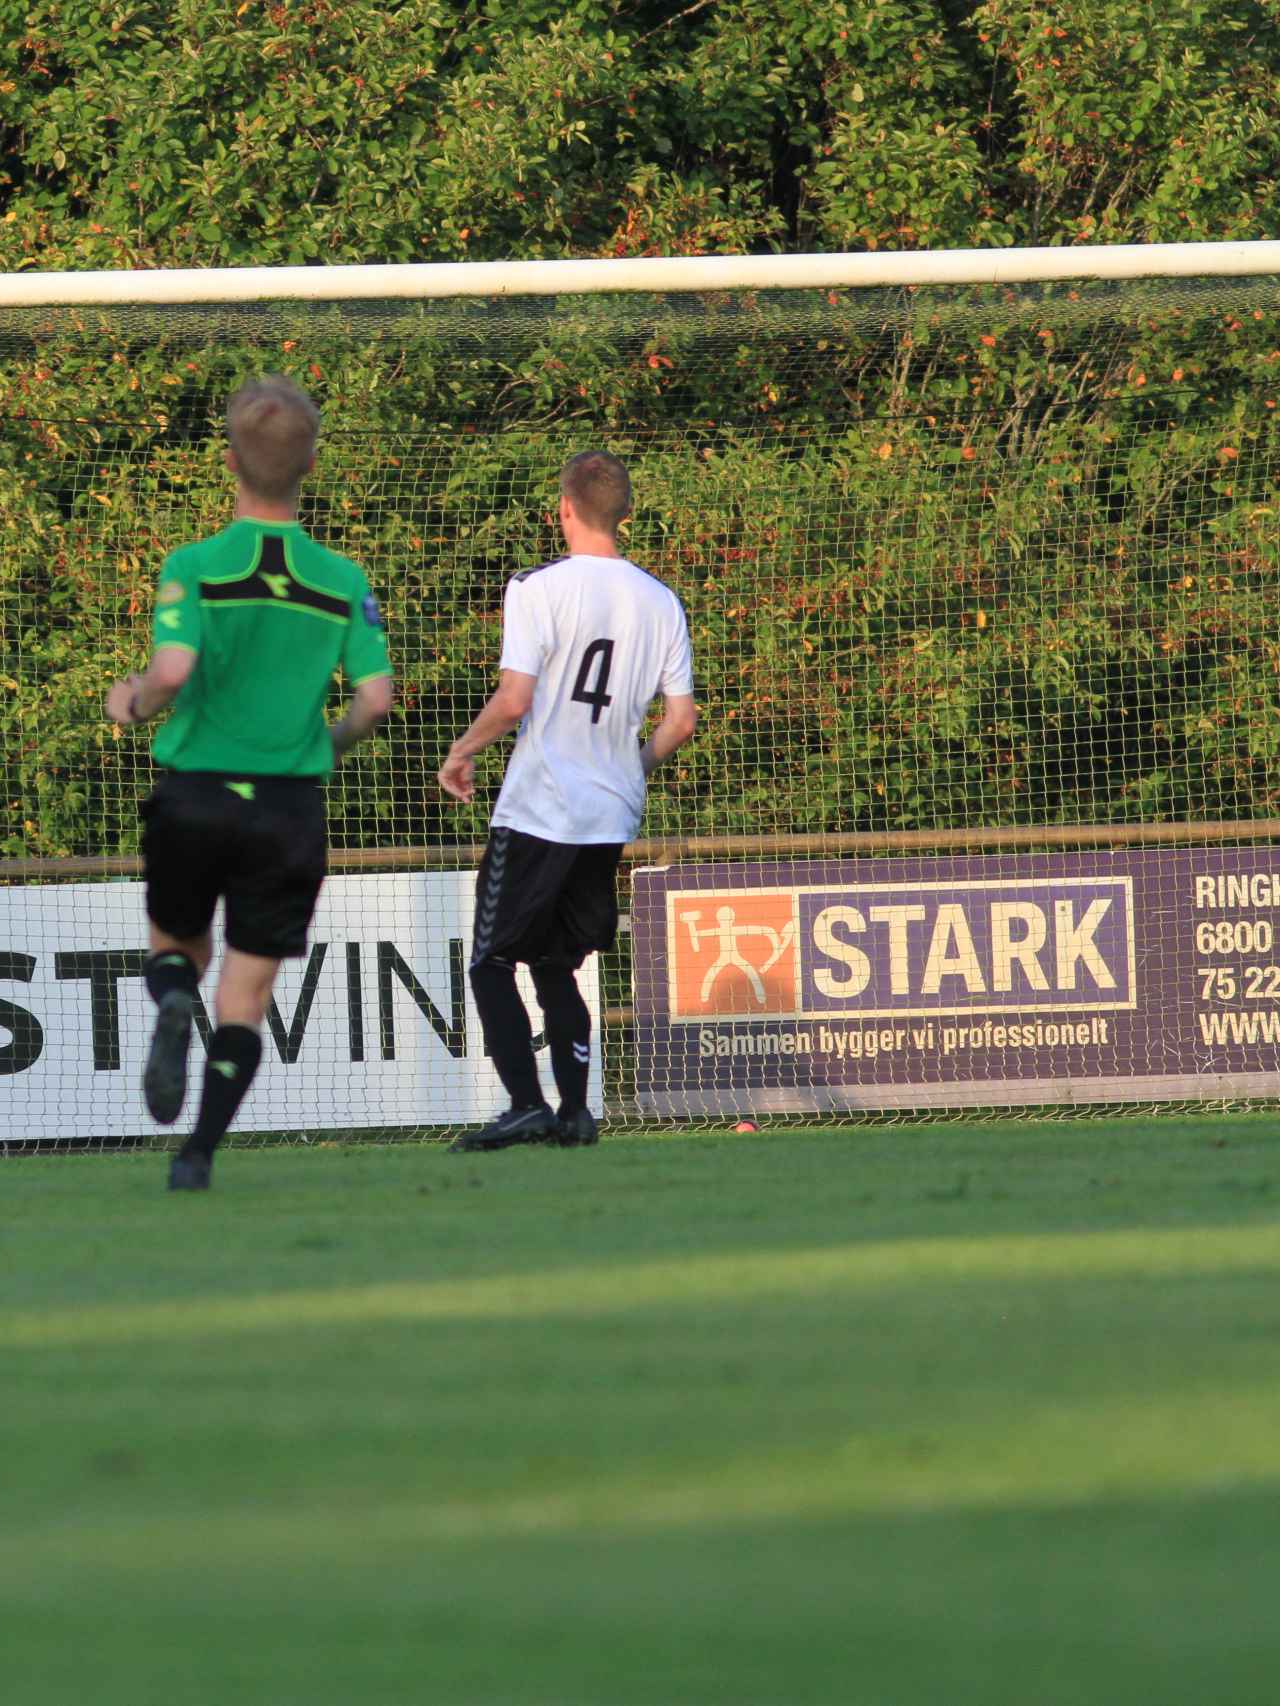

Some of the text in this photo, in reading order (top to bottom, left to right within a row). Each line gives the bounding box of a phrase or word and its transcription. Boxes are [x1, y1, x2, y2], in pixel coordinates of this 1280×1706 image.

[571, 638, 615, 724] 4
[813, 898, 1117, 999] STARK
[1196, 920, 1272, 954] 6800
[1198, 967, 1236, 1000] 75
[699, 1017, 1108, 1058] Sammen bygger vi professionelt
